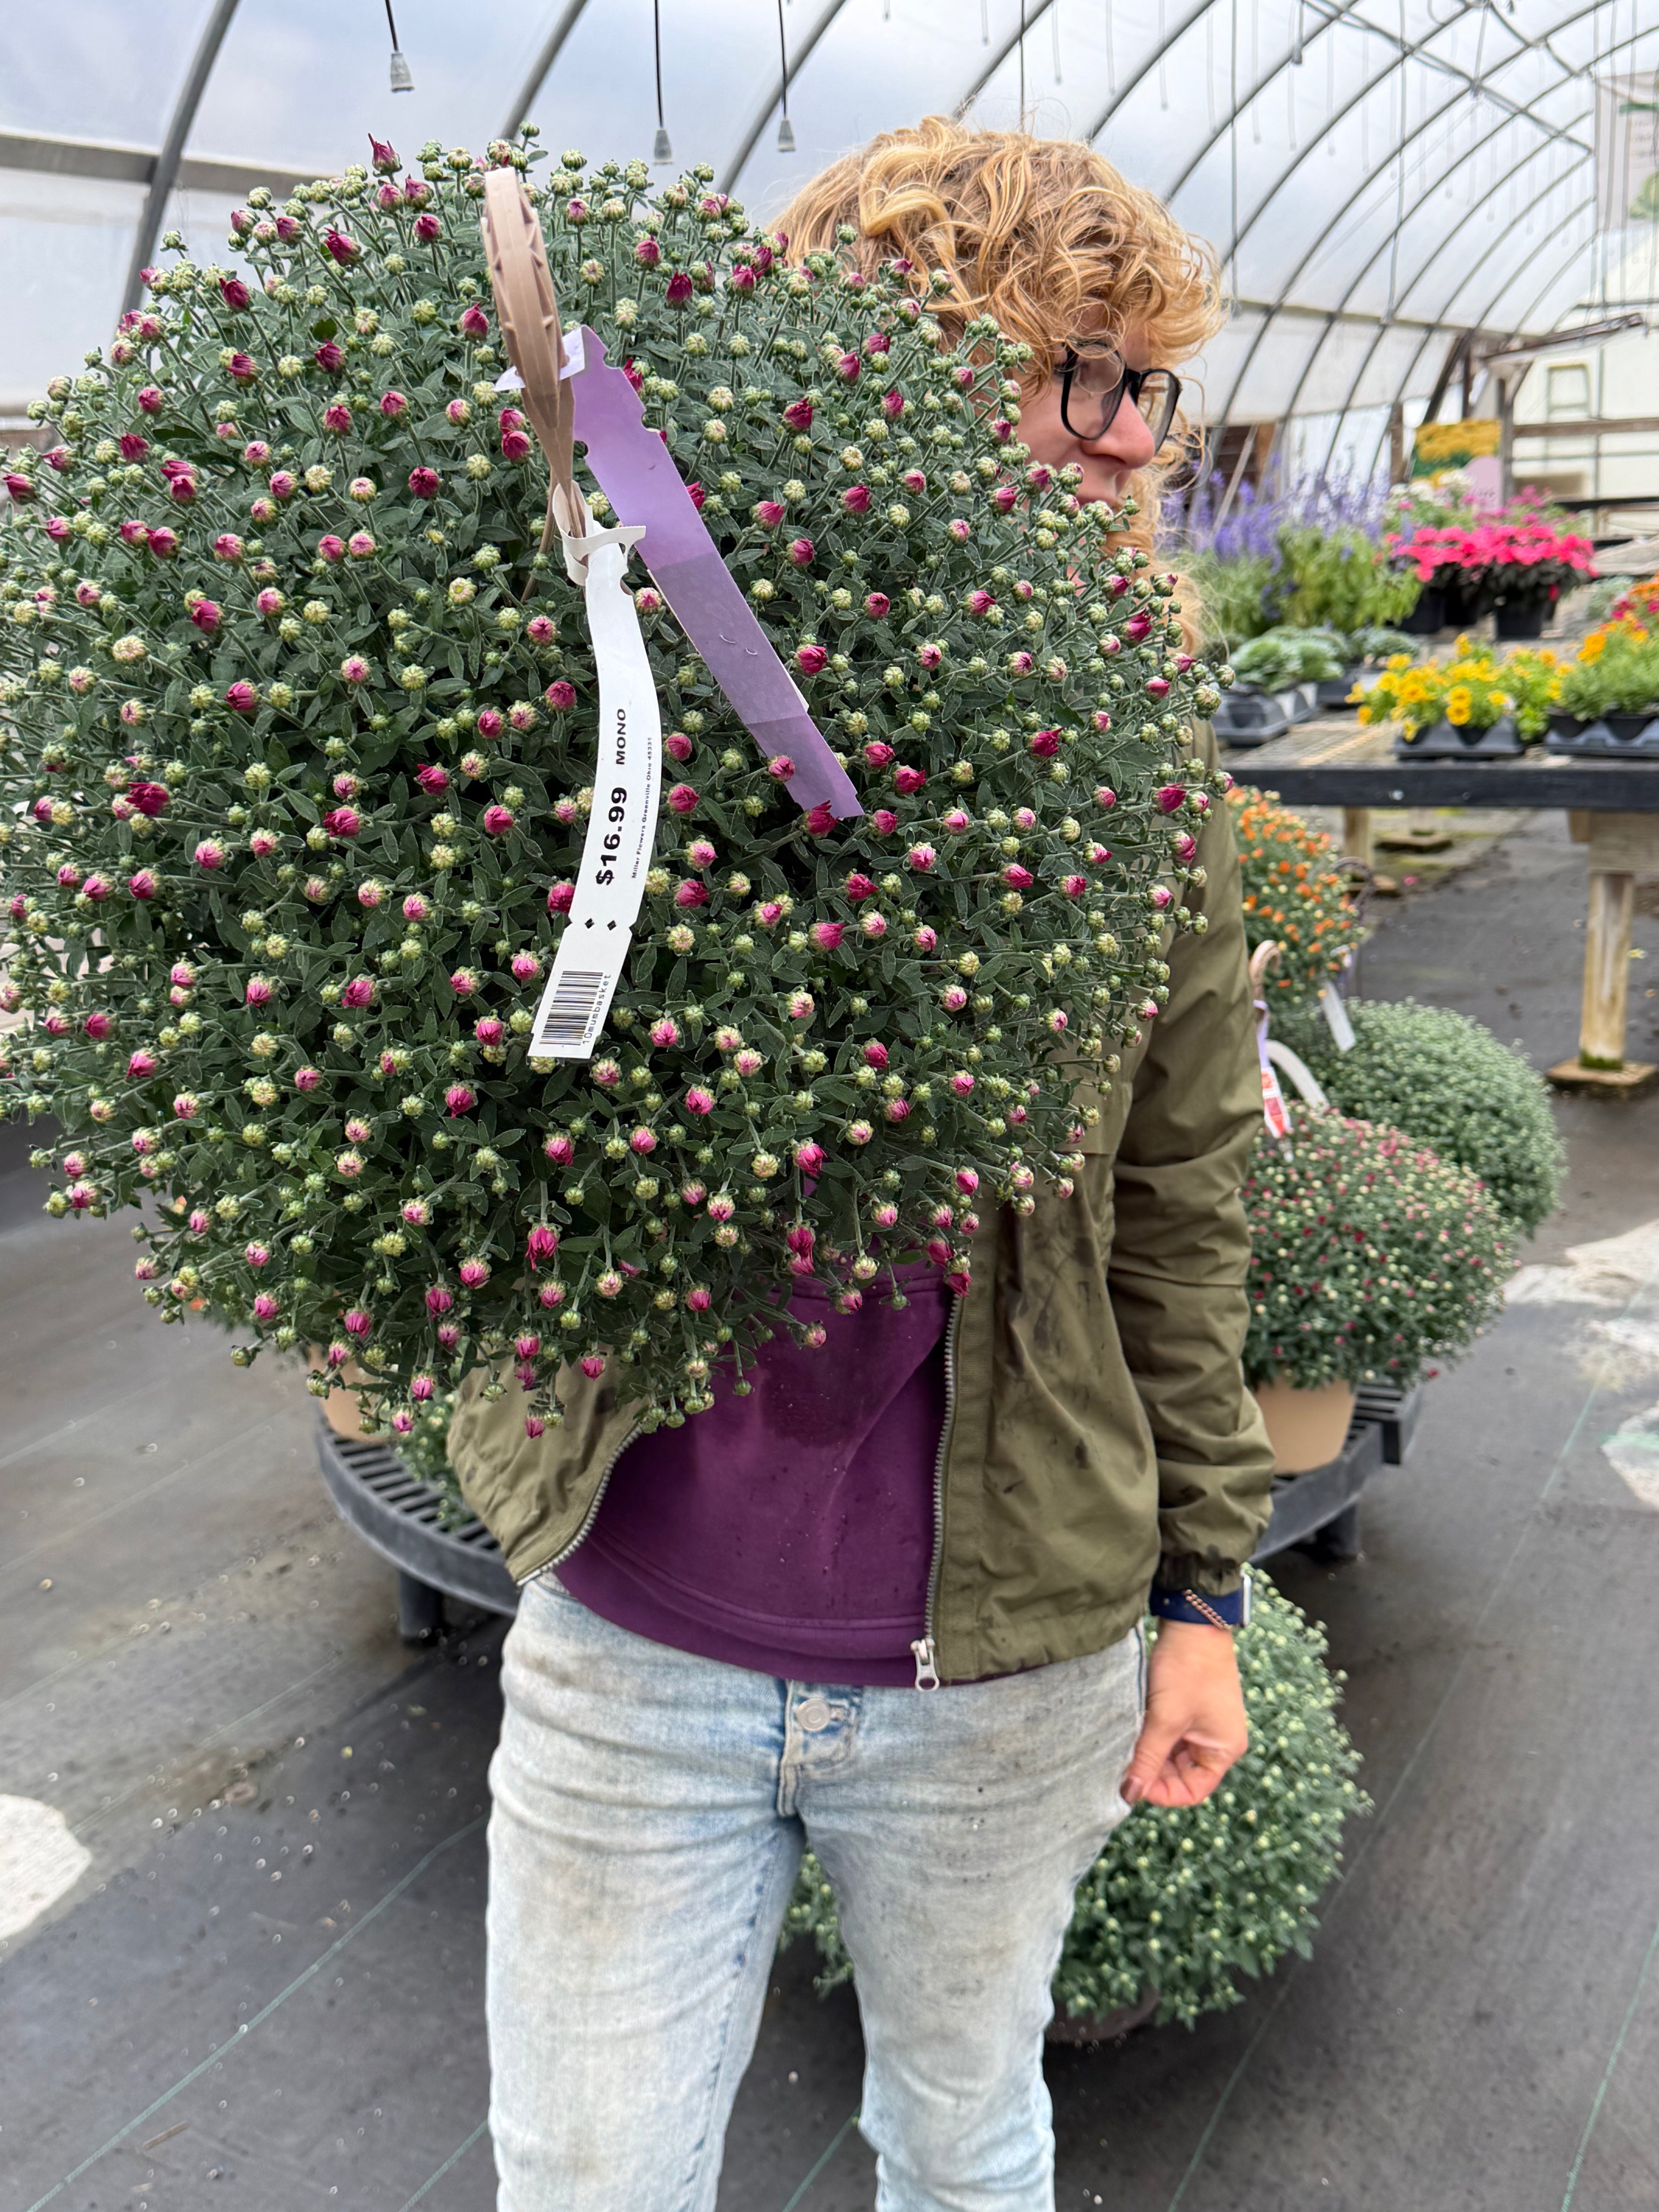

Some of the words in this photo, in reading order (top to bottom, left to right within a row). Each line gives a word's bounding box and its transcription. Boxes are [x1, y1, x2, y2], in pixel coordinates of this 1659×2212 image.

[595, 787, 627, 886] $16.99
[616, 708, 626, 765] MONO
[631, 857, 639, 878] Miller
[636, 825, 646, 855] Flowers
[642, 783, 650, 823] Greenville
[582, 974, 611, 1045] 10mumbasket
